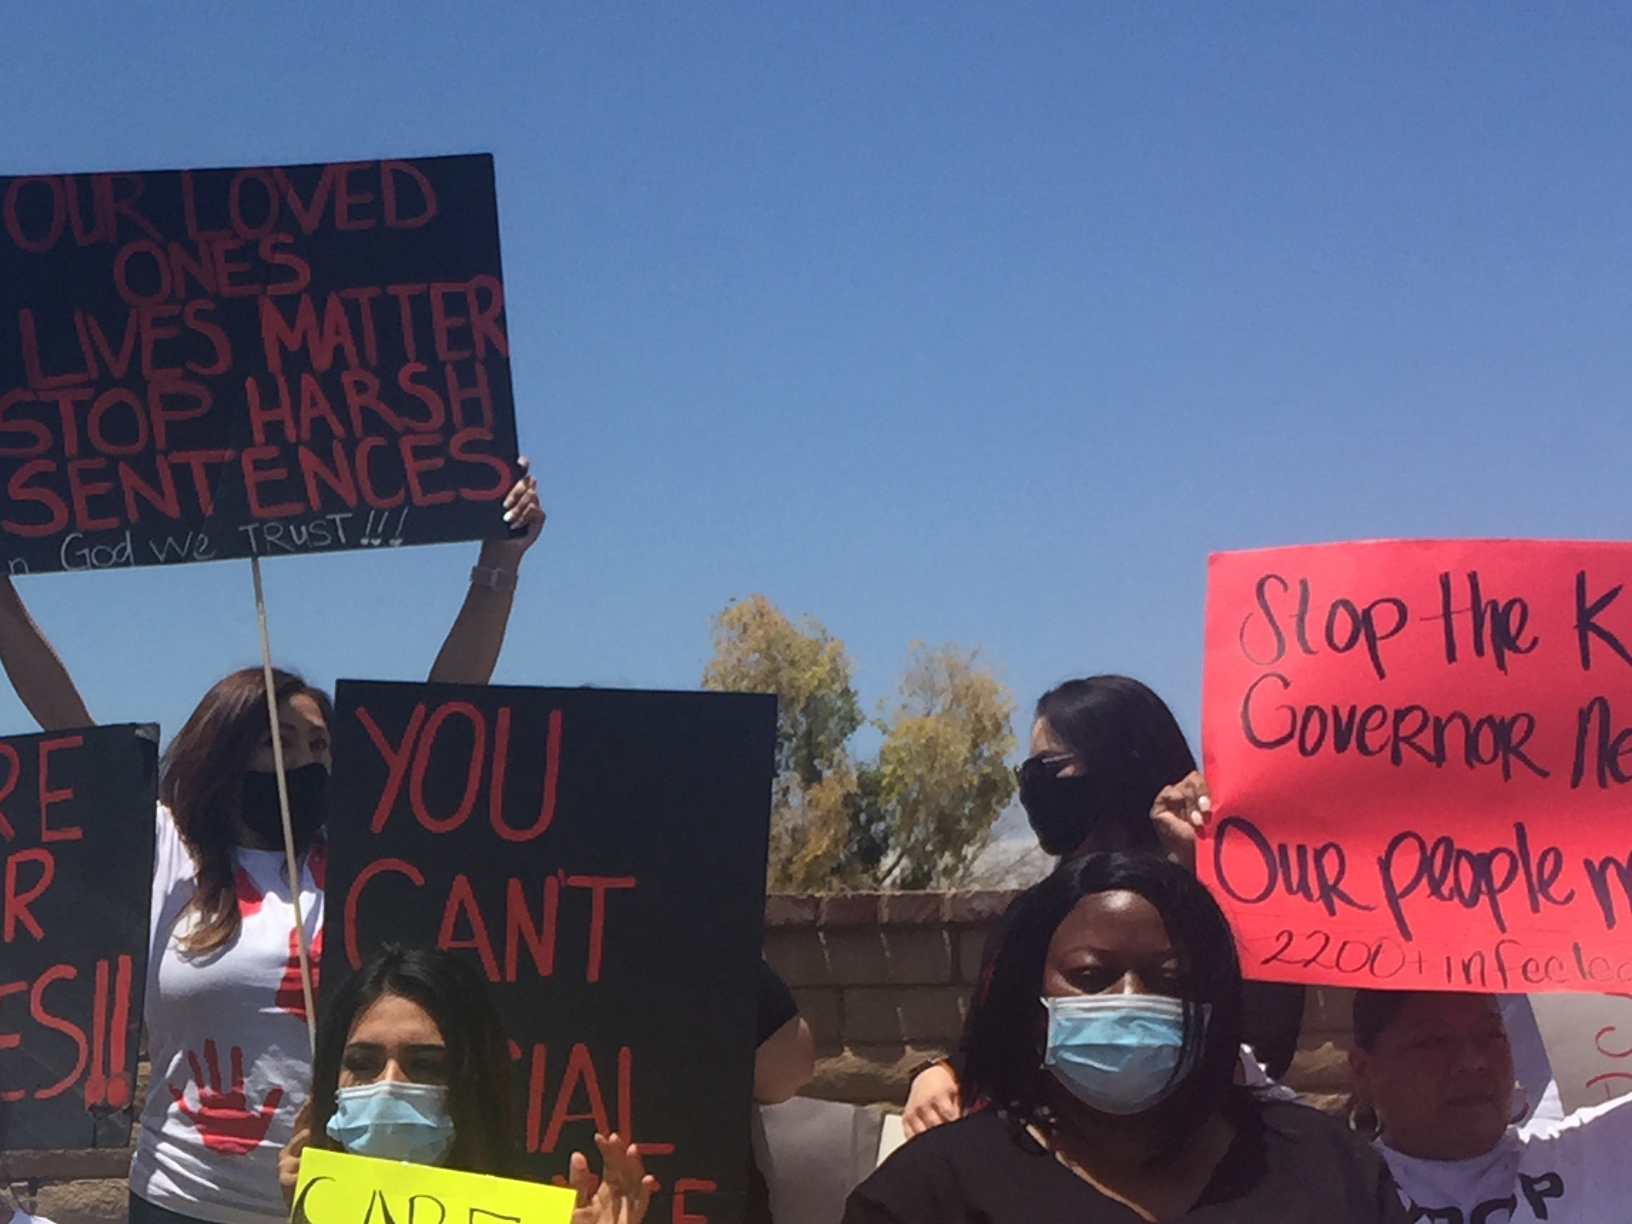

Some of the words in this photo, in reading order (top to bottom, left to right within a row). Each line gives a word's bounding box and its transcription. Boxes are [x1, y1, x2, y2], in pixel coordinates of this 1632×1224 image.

[2, 172, 161, 252] OUR
[180, 159, 438, 244] LOVED
[114, 231, 312, 302] ONES
[18, 300, 232, 389] LIVES
[258, 275, 509, 374] MATTER
[245, 361, 494, 444] HARSH
[2, 428, 511, 537] SENTENCES
[60, 531, 135, 572] God
[239, 507, 410, 555] TRUST!!!
[1239, 573, 1409, 681] Stop
[1420, 570, 1539, 676] the
[355, 701, 562, 842] YOU
[1261, 930, 1428, 978] 2200+
